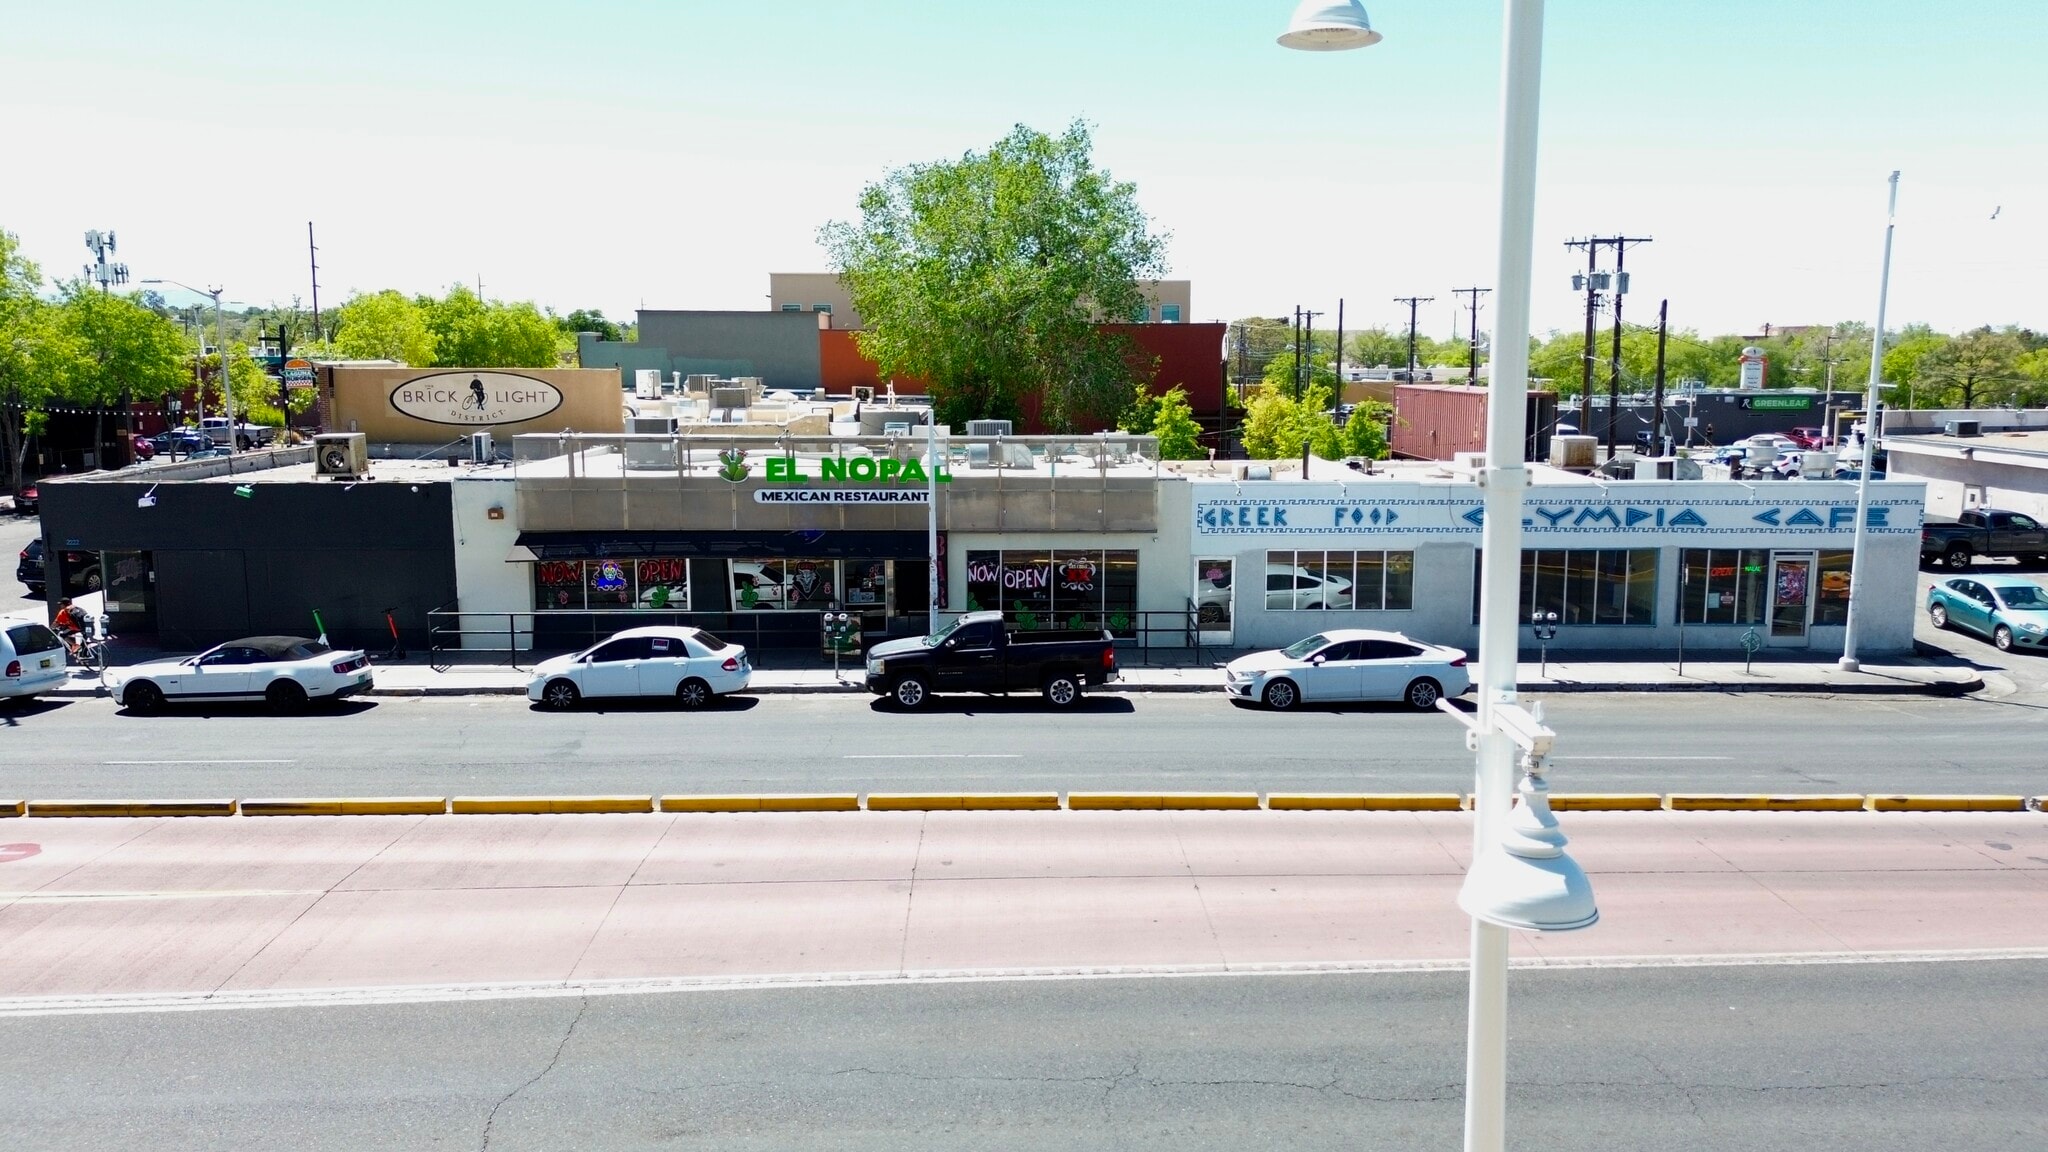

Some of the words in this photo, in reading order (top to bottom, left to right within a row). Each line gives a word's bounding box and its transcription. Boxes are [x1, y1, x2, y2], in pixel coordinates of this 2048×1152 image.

[403, 388, 457, 403] BRICK
[495, 390, 549, 403] LIGHT
[1754, 399, 1807, 407] GREENLEAF
[451, 410, 504, 422] DISTRICT
[766, 458, 808, 482] EL
[821, 457, 953, 483] NOPAL
[762, 491, 831, 502] MEXICAN
[834, 491, 930, 502] RESTAURANT
[1203, 507, 1288, 527] GREEK
[1334, 507, 1399, 527] FOOD
[1752, 507, 1890, 528] CAFE
[540, 560, 583, 583] NOW
[638, 559, 685, 584] OPEN
[968, 564, 999, 582] NOW
[1004, 566, 1049, 589] OPEN
[1711, 567, 1734, 577] OPEN
